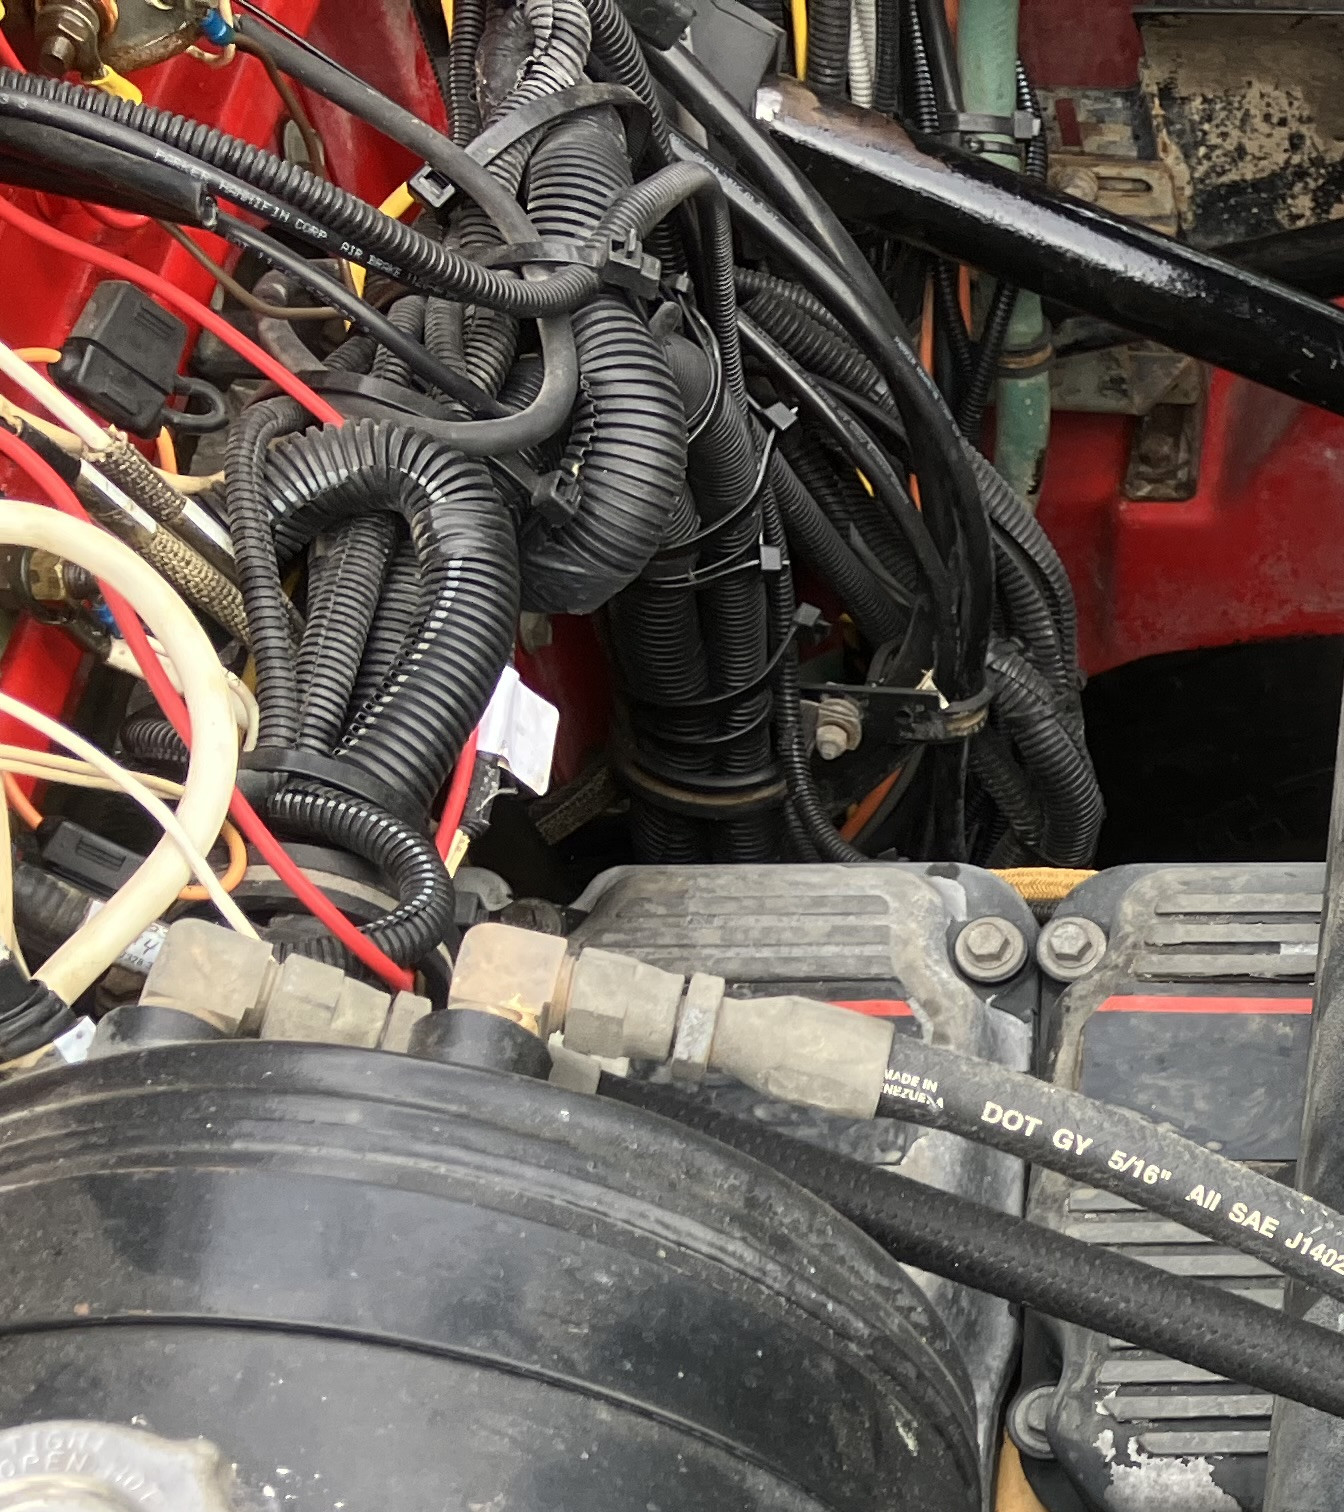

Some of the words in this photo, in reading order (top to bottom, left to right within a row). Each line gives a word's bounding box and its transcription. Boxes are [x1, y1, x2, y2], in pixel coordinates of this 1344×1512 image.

[294, 218, 329, 240] CORP
[340, 241, 364, 260] AIR
[883, 1069, 921, 1089] MADE
[922, 1077, 938, 1093] IN
[980, 1100, 1043, 1138] DOT
[1052, 1128, 1094, 1156] GY
[1107, 1150, 1172, 1185] 5/16"
[1228, 1202, 1280, 1239] SAE
